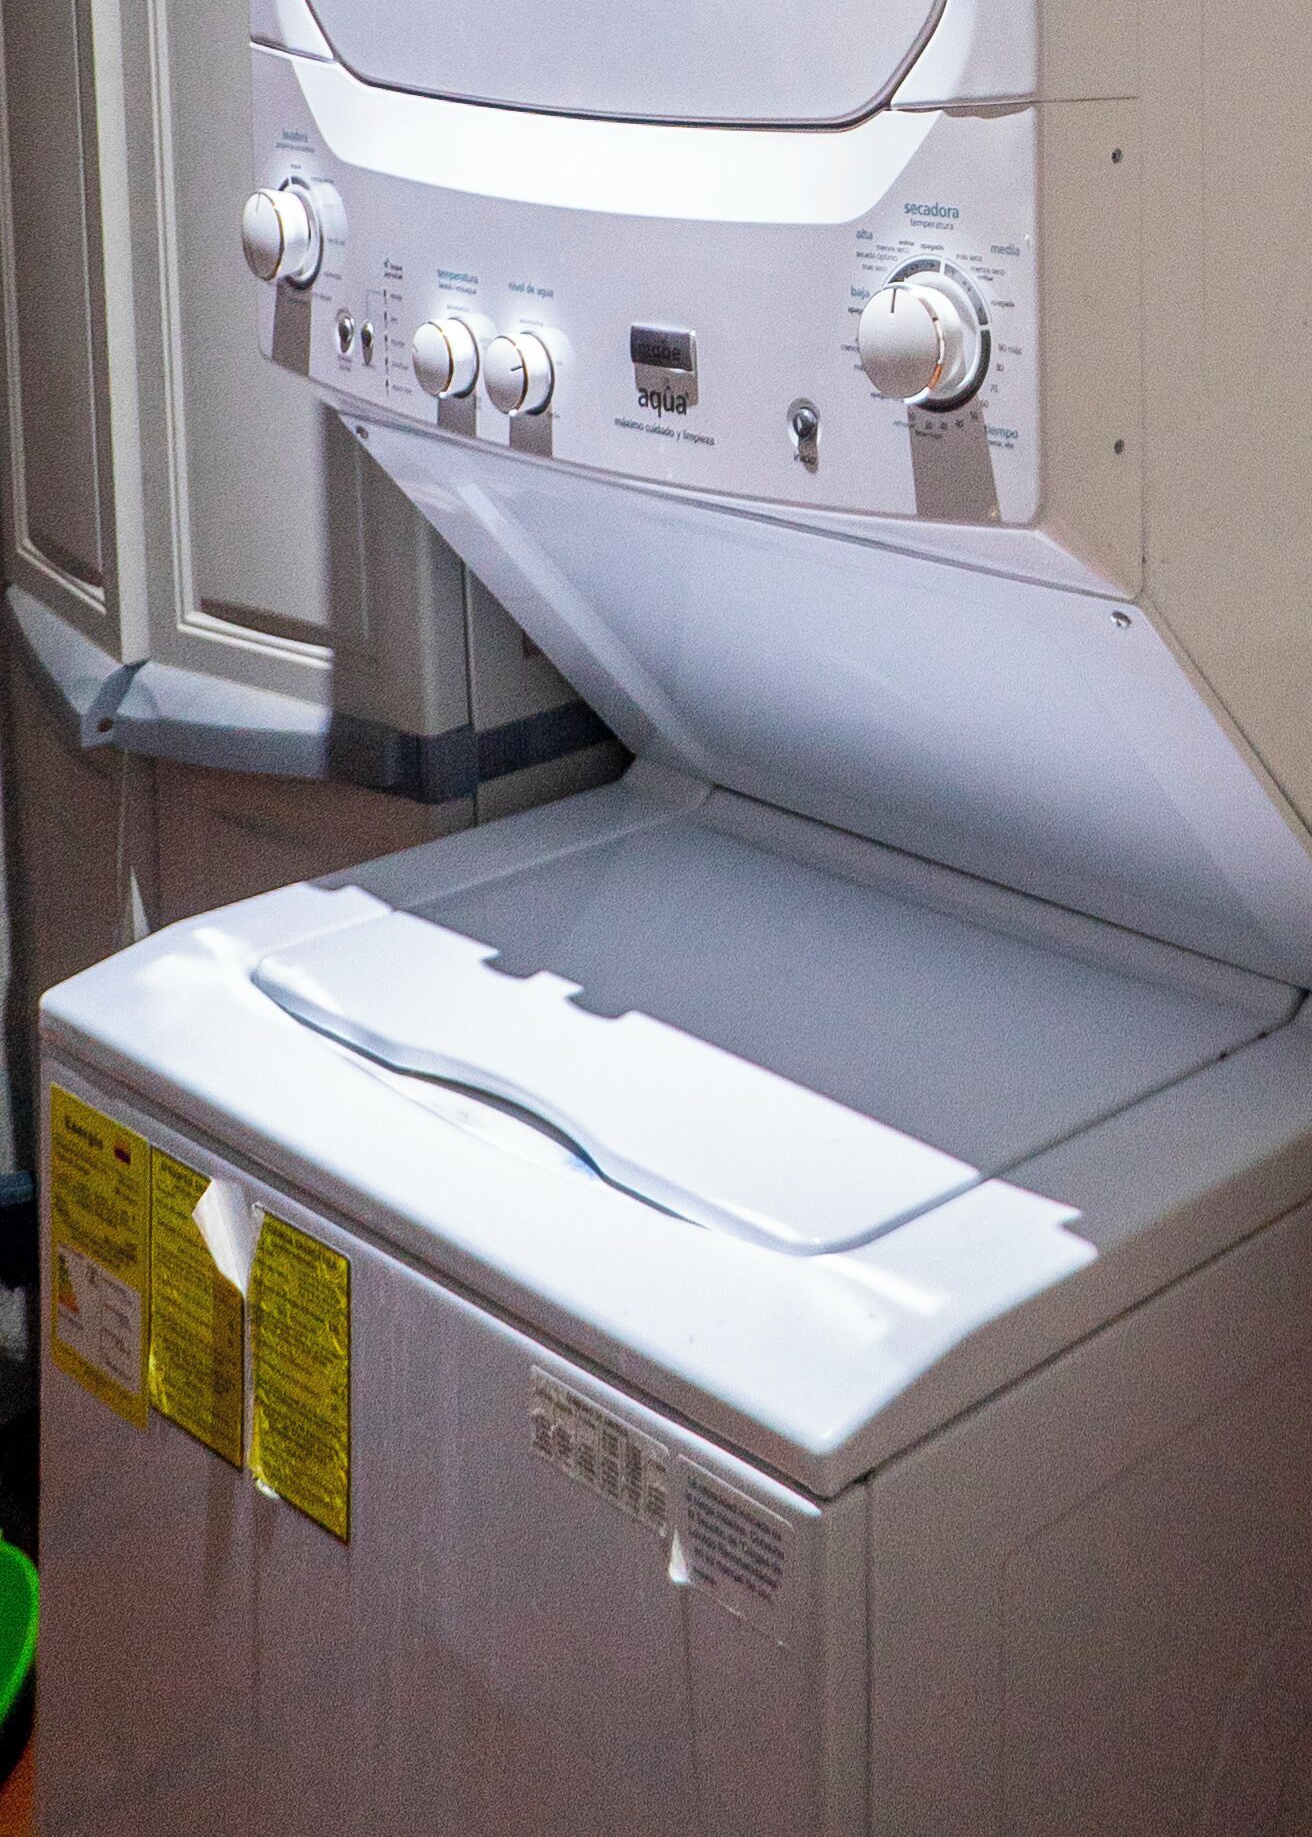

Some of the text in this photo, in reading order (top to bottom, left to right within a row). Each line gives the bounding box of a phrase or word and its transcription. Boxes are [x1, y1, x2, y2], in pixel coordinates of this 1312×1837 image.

[904, 202, 960, 218] secadora
[910, 218, 954, 230] temperatura
[856, 228, 873, 240] alta
[990, 244, 1021, 257] media
[850, 285, 870, 299] baja
[614, 417, 644, 431] máximo
[676, 430, 681, 442] y
[683, 431, 715, 446] limpieza
